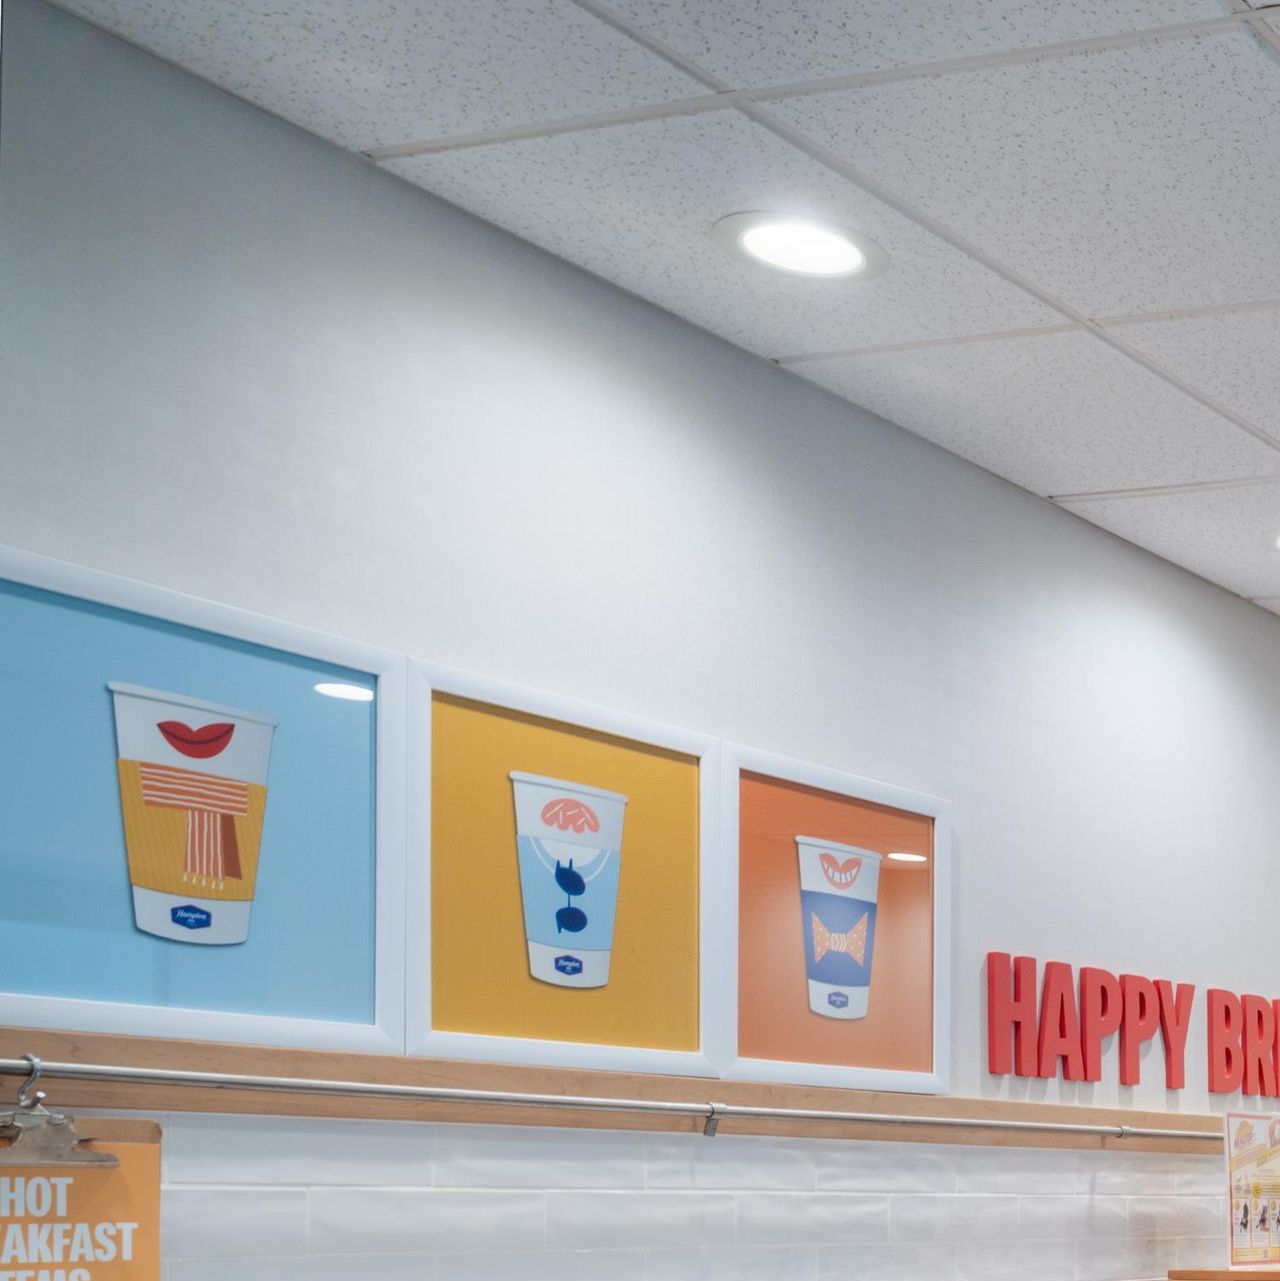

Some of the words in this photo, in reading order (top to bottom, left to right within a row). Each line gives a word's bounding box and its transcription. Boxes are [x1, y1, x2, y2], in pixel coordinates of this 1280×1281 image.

[987, 951, 1196, 1089] HAPPY
[0, 1176, 75, 1218] HOT
[0, 1221, 139, 1264] AKFAST
